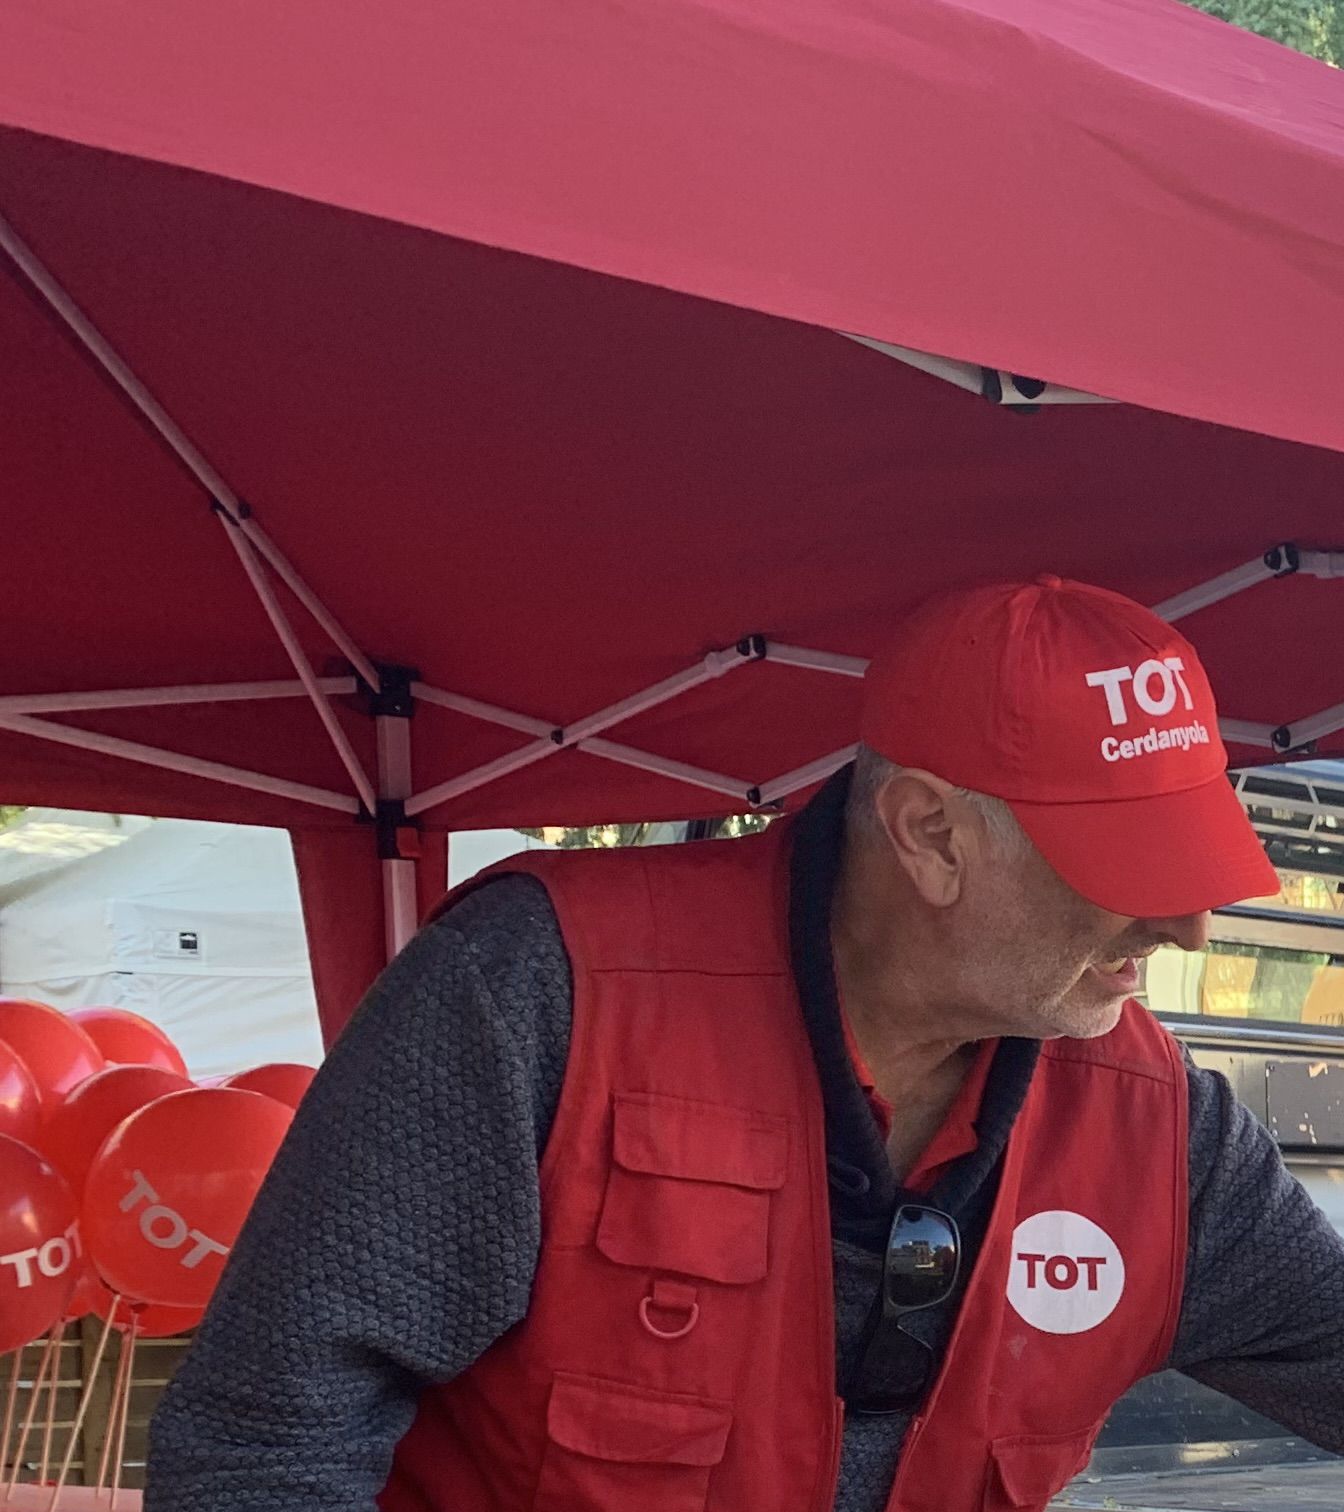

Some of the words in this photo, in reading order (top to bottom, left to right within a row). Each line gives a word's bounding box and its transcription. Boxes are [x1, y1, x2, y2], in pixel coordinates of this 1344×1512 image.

[1085, 657, 1194, 726] TOT
[1101, 720, 1210, 762] Cerdanyola
[119, 1169, 230, 1269] TOT
[0, 1219, 83, 1289] TOT
[1017, 1252, 1107, 1291] TOT
